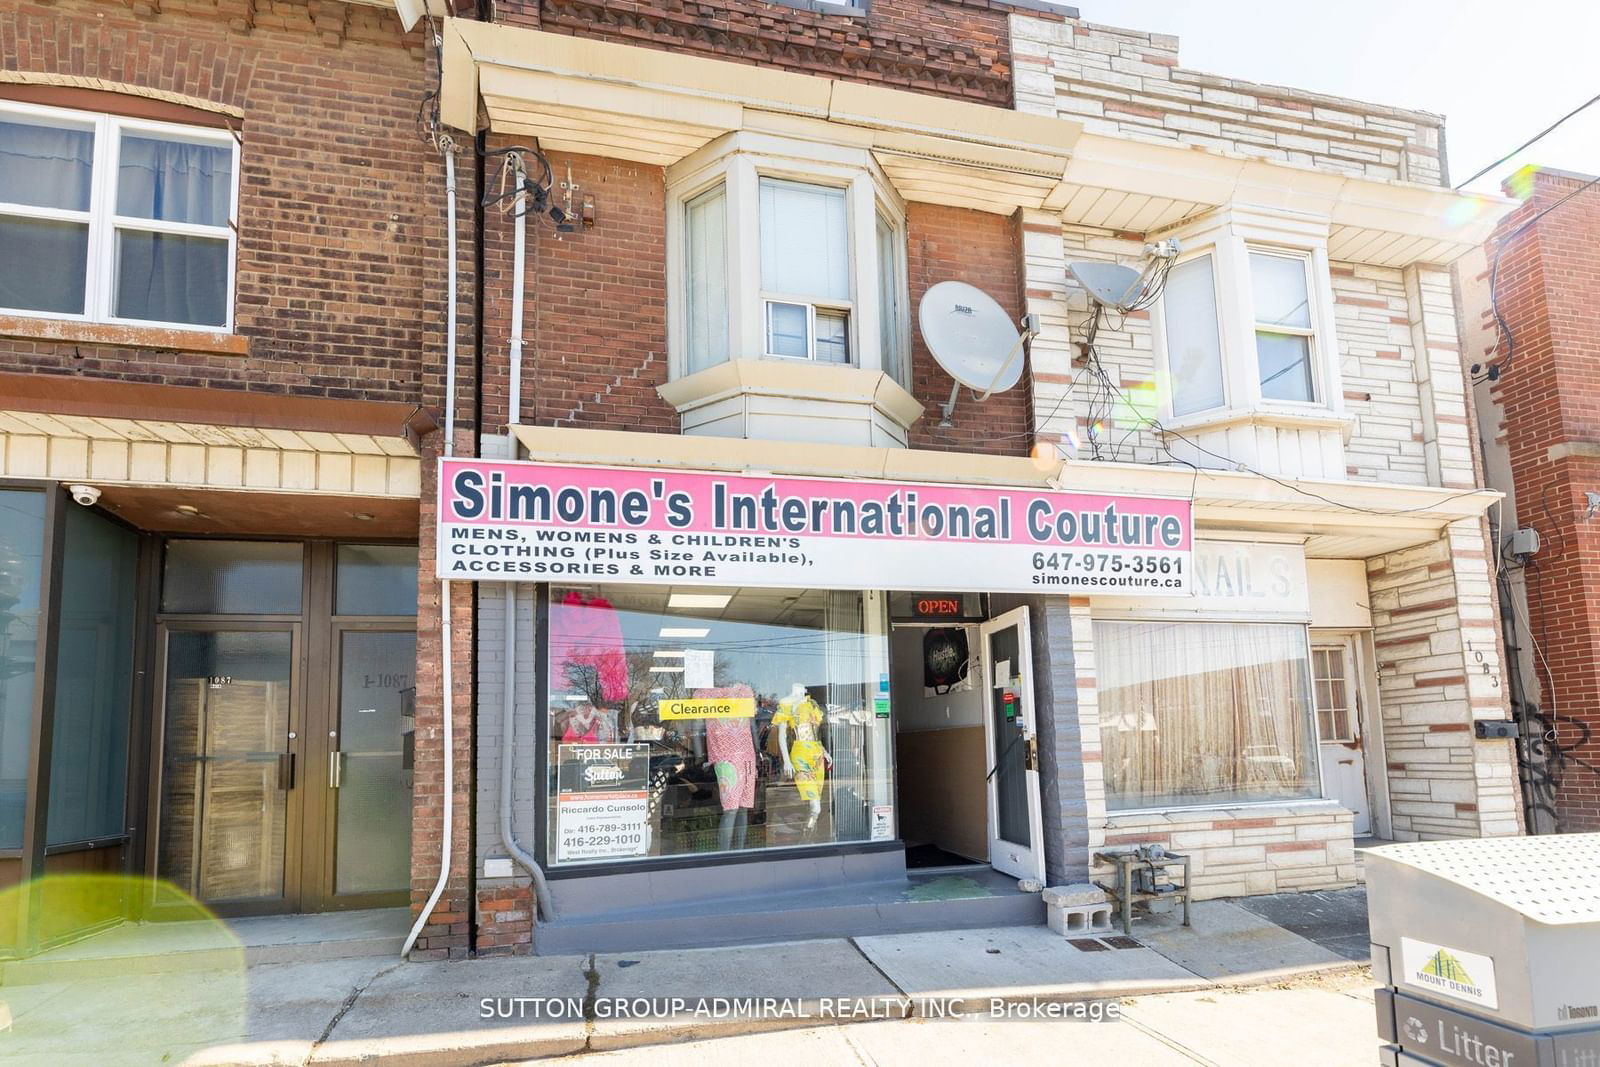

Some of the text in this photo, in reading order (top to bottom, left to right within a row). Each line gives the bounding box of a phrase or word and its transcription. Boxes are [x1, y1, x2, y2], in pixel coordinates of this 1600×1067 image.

[452, 470, 1183, 547] Simone's International Couture
[452, 527, 801, 549] MENS, WOMENS & CHILDREN'S
[451, 544, 814, 567] CLOTHING (Plus Size Available),
[1031, 551, 1183, 575] 647-975-3561
[452, 560, 716, 577] ACCESSORIES & MORE
[1031, 572, 1183, 589] simonescouture.ca
[918, 600, 958, 614] OPEN
[209, 676, 232, 685] 1087
[670, 703, 731, 714] Clearance
[576, 748, 633, 760] FOR SALE
[561, 804, 646, 814] Riccardo Cunsolo
[577, 823, 641, 833] 416-789-3111
[563, 834, 641, 847] 416-229-1010
[1416, 971, 1483, 998] MOUNT DENNIS
[1438, 1019, 1515, 1067] Litter
